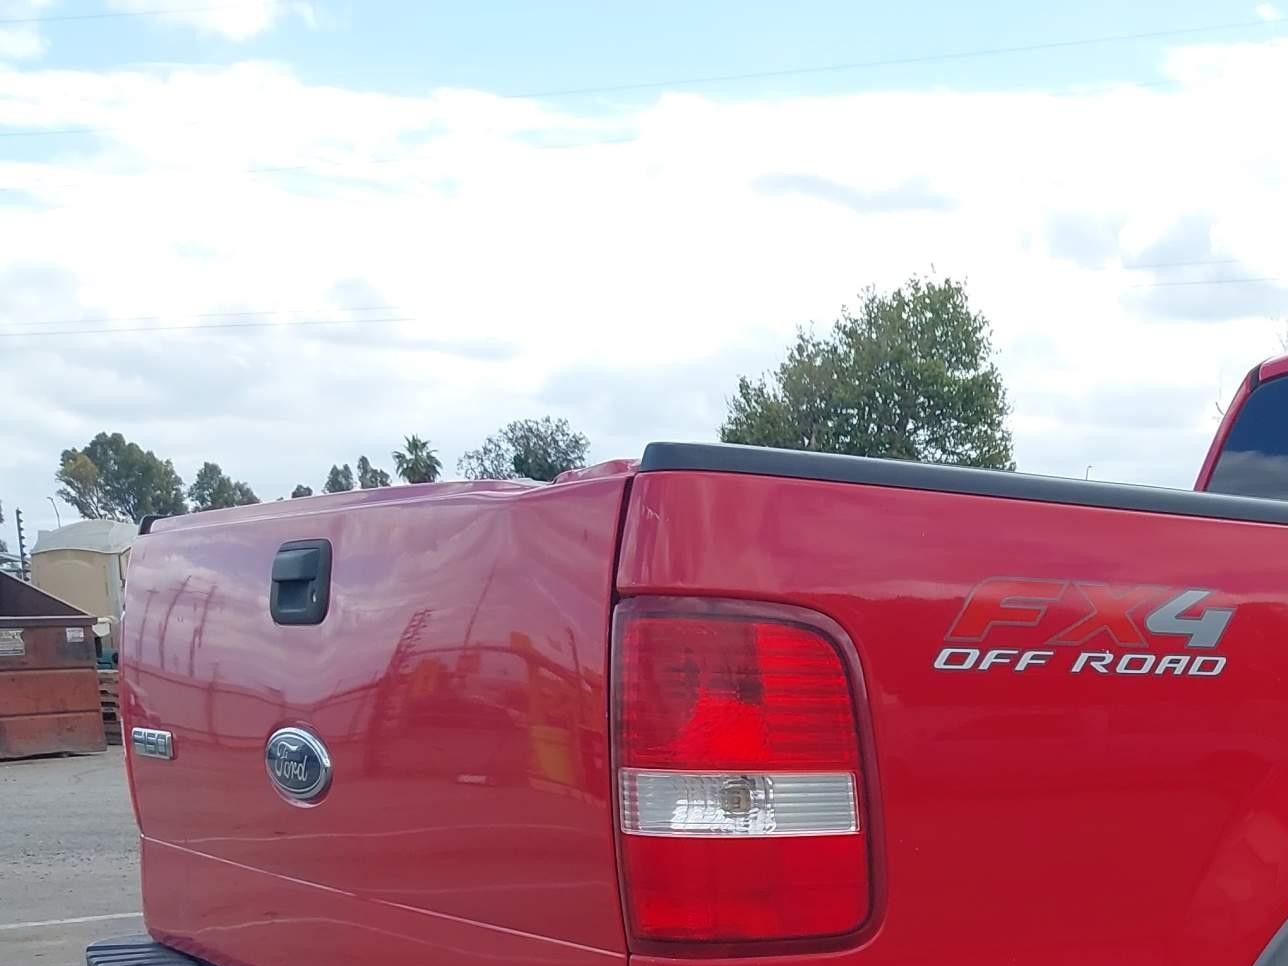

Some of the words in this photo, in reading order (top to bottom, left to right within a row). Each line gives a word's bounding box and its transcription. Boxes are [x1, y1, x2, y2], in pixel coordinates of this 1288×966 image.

[944, 576, 1236, 648] FX4
[934, 648, 1054, 671] OFF
[1071, 651, 1227, 676] ROAD
[275, 741, 308, 782] Ford
